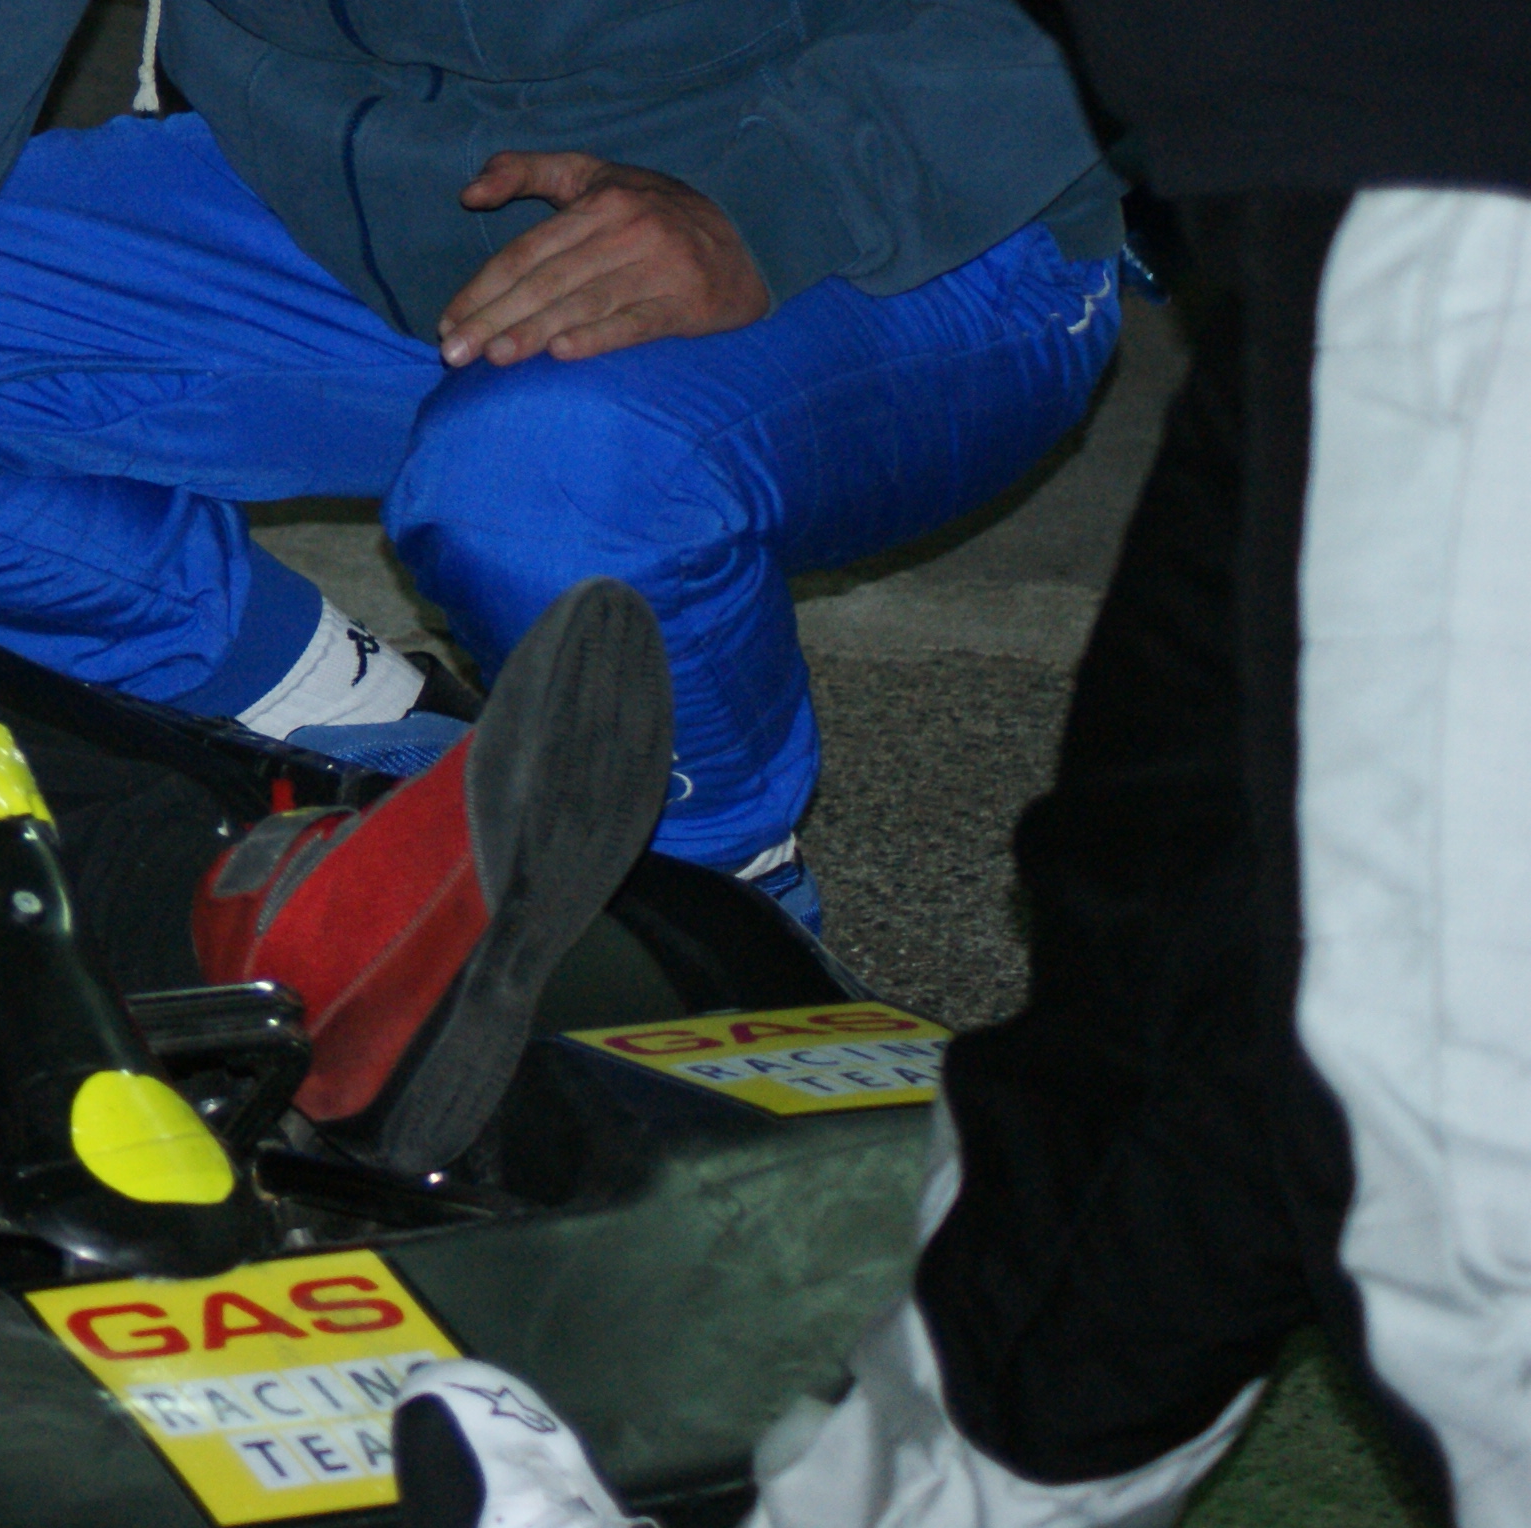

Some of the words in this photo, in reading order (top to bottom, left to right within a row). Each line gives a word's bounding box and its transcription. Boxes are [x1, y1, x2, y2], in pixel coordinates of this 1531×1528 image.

[604, 1011, 919, 1055] GAS
[788, 1065, 940, 1093] TEA
[65, 1276, 405, 1361] GAS
[243, 1429, 397, 1478] TEA
